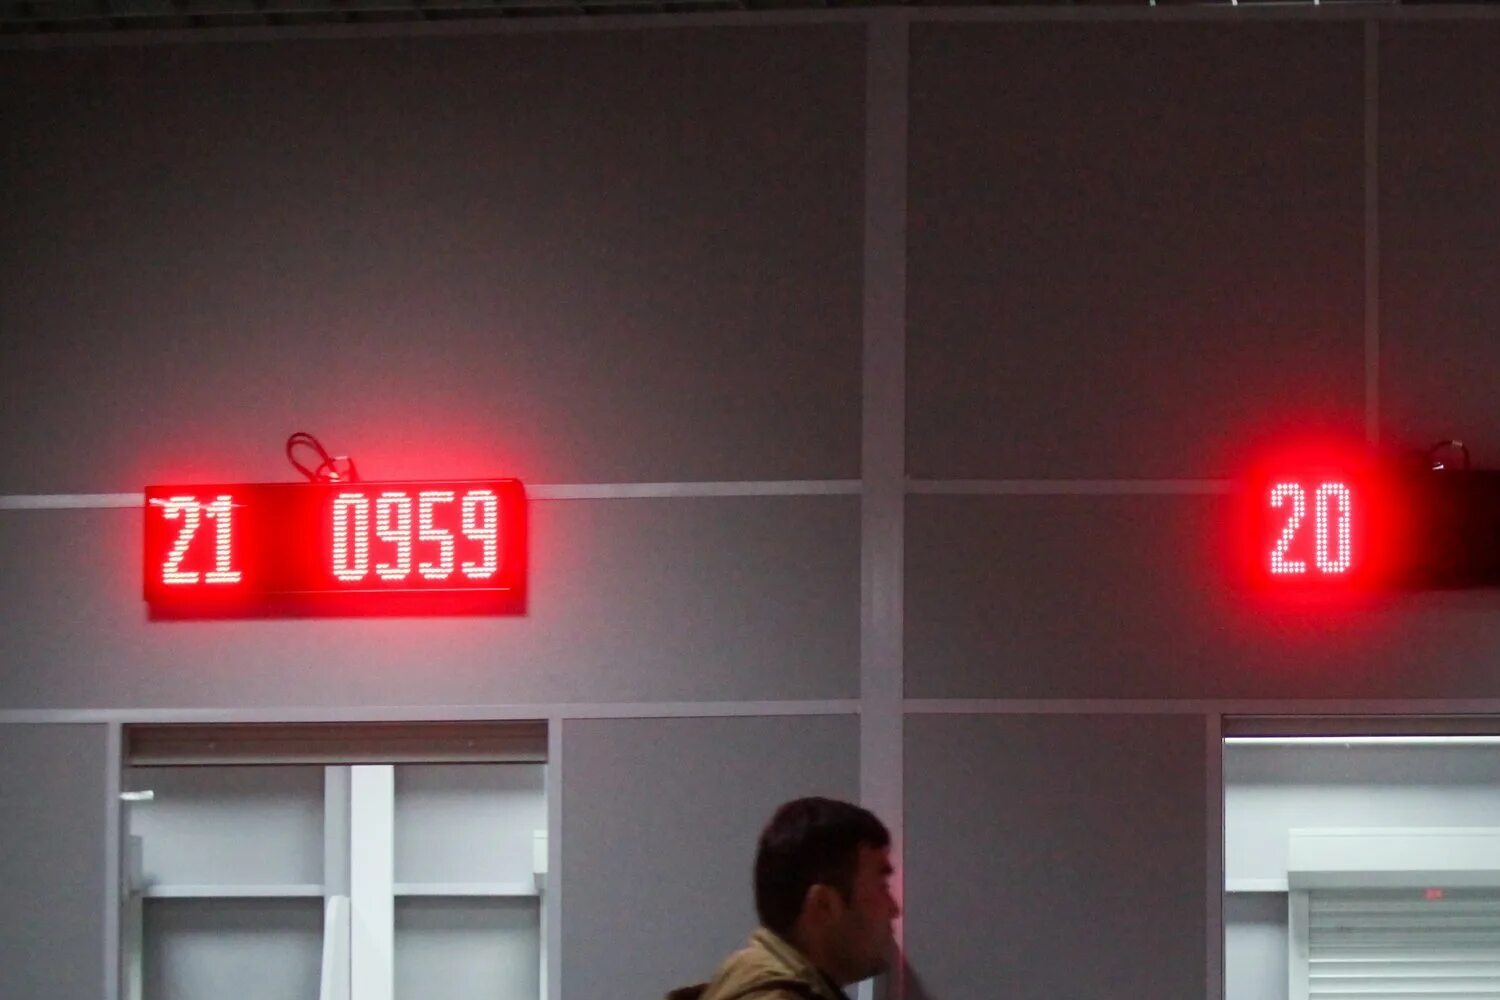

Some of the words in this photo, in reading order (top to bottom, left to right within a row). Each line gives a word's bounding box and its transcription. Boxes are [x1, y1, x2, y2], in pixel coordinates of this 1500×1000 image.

[163, 495, 241, 583] 21
[333, 490, 498, 580] 0959
[1270, 482, 1351, 574] 20
